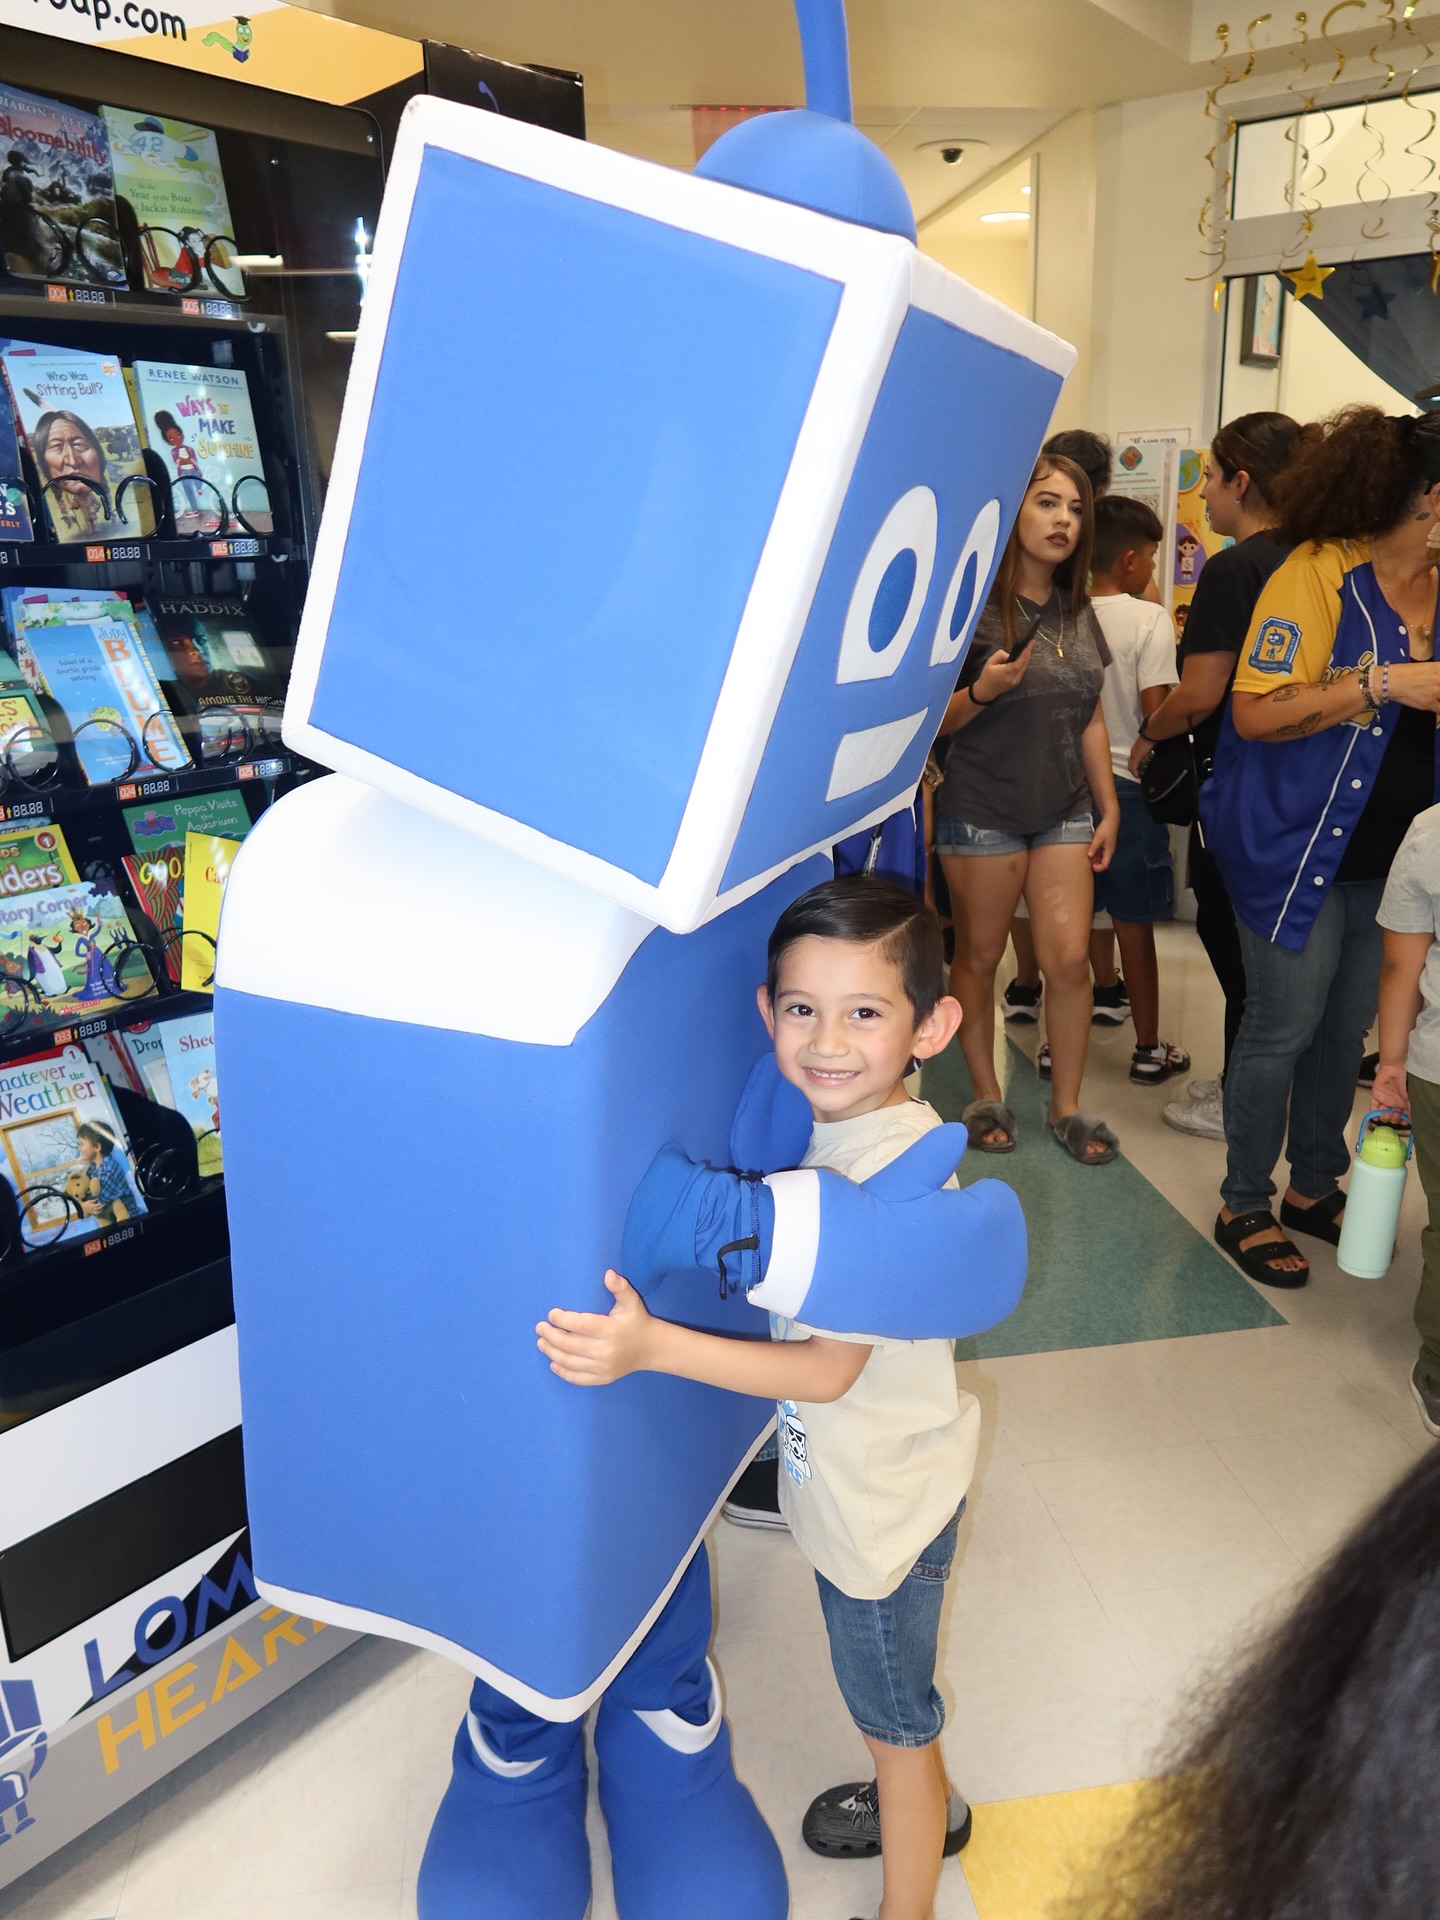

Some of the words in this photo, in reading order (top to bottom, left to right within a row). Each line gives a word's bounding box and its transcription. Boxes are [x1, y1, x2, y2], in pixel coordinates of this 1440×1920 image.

[131, 136, 163, 152] 42
[130, 188, 149, 200] Year
[171, 193, 191, 202] Boar
[141, 202, 167, 213] Jackie
[171, 204, 212, 218] Robinson
[49, 288, 67, 299] 004
[75, 289, 105, 304] 88.88
[185, 301, 199, 312] 005
[206, 302, 232, 315] 88.88
[46, 371, 67, 381] Who
[69, 371, 89, 380] Was
[149, 368, 187, 380] RENÉE
[192, 373, 239, 385] WATSON
[36, 383, 78, 399] Sitting
[78, 382, 104, 396] Bull?
[176, 394, 216, 417] WAYS
[199, 418, 236, 439] MAKE
[87, 548, 104, 559] 014
[112, 546, 141, 559] 88.88
[213, 544, 228, 554] 015
[234, 541, 259, 554] 88.88
[160, 603, 245, 616] HADDIX
[103, 638, 176, 763] BLUME
[198, 695, 236, 706] AMONG
[237, 695, 254, 704] THE
[239, 768, 253, 777] 025
[119, 787, 135, 798] 024
[143, 780, 170, 795] 88.88
[12, 801, 43, 817] 88.88
[174, 804, 207, 818] Peppa
[208, 799, 237, 810] Visits
[187, 818, 238, 834] Aquarium
[42, 836, 51, 848] 1
[36, 895, 88, 914] Corner
[55, 1032, 71, 1042] 033
[79, 1020, 107, 1037] 88.88
[68, 1050, 76, 1060] 1
[69, 1072, 85, 1081] the
[107, 1227, 134, 1246] 88.88
